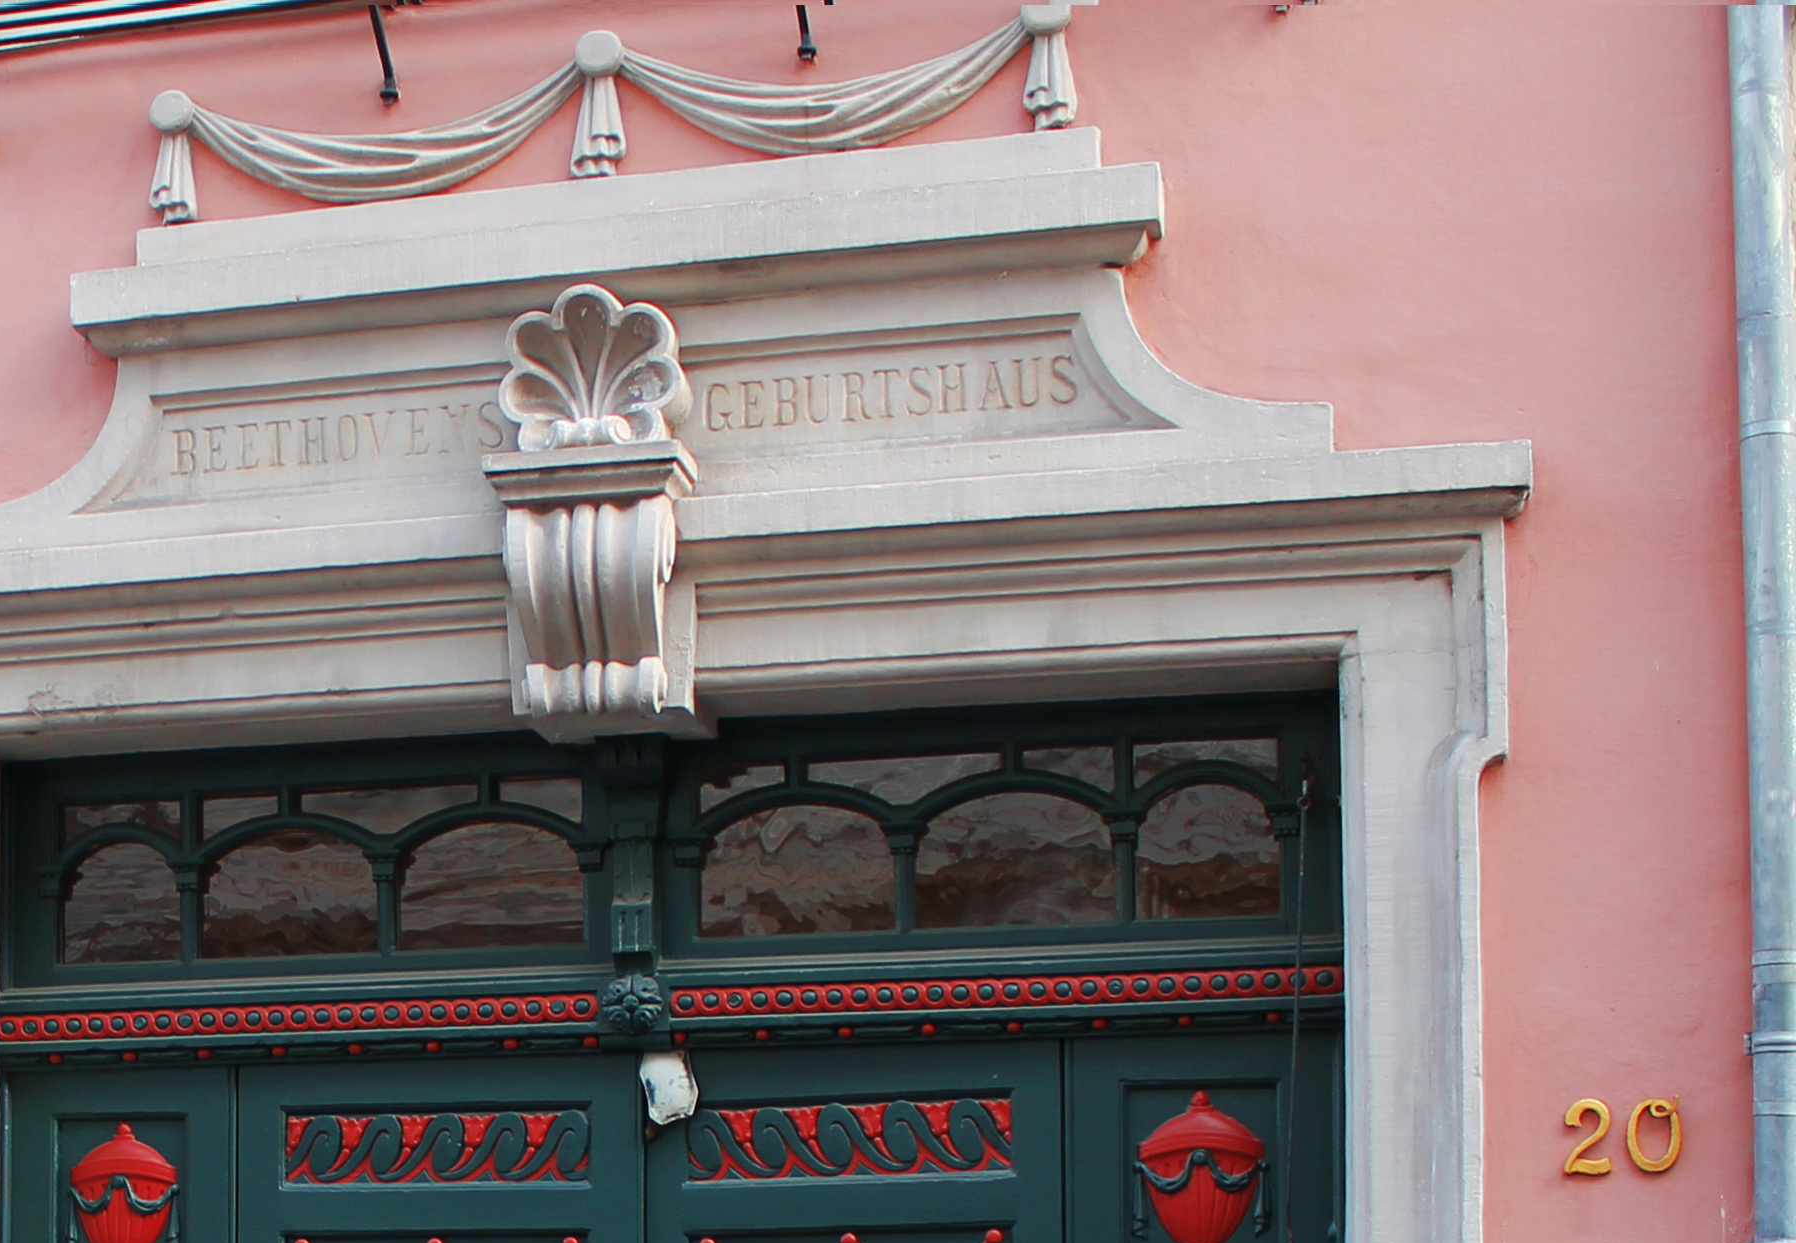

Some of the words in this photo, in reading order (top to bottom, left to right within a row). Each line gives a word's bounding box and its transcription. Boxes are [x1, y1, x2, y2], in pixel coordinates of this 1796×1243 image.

[170, 401, 505, 477] BEETHOVENS
[706, 354, 1079, 433] GEBURTSHAUS
[1563, 1094, 1682, 1176] 20
